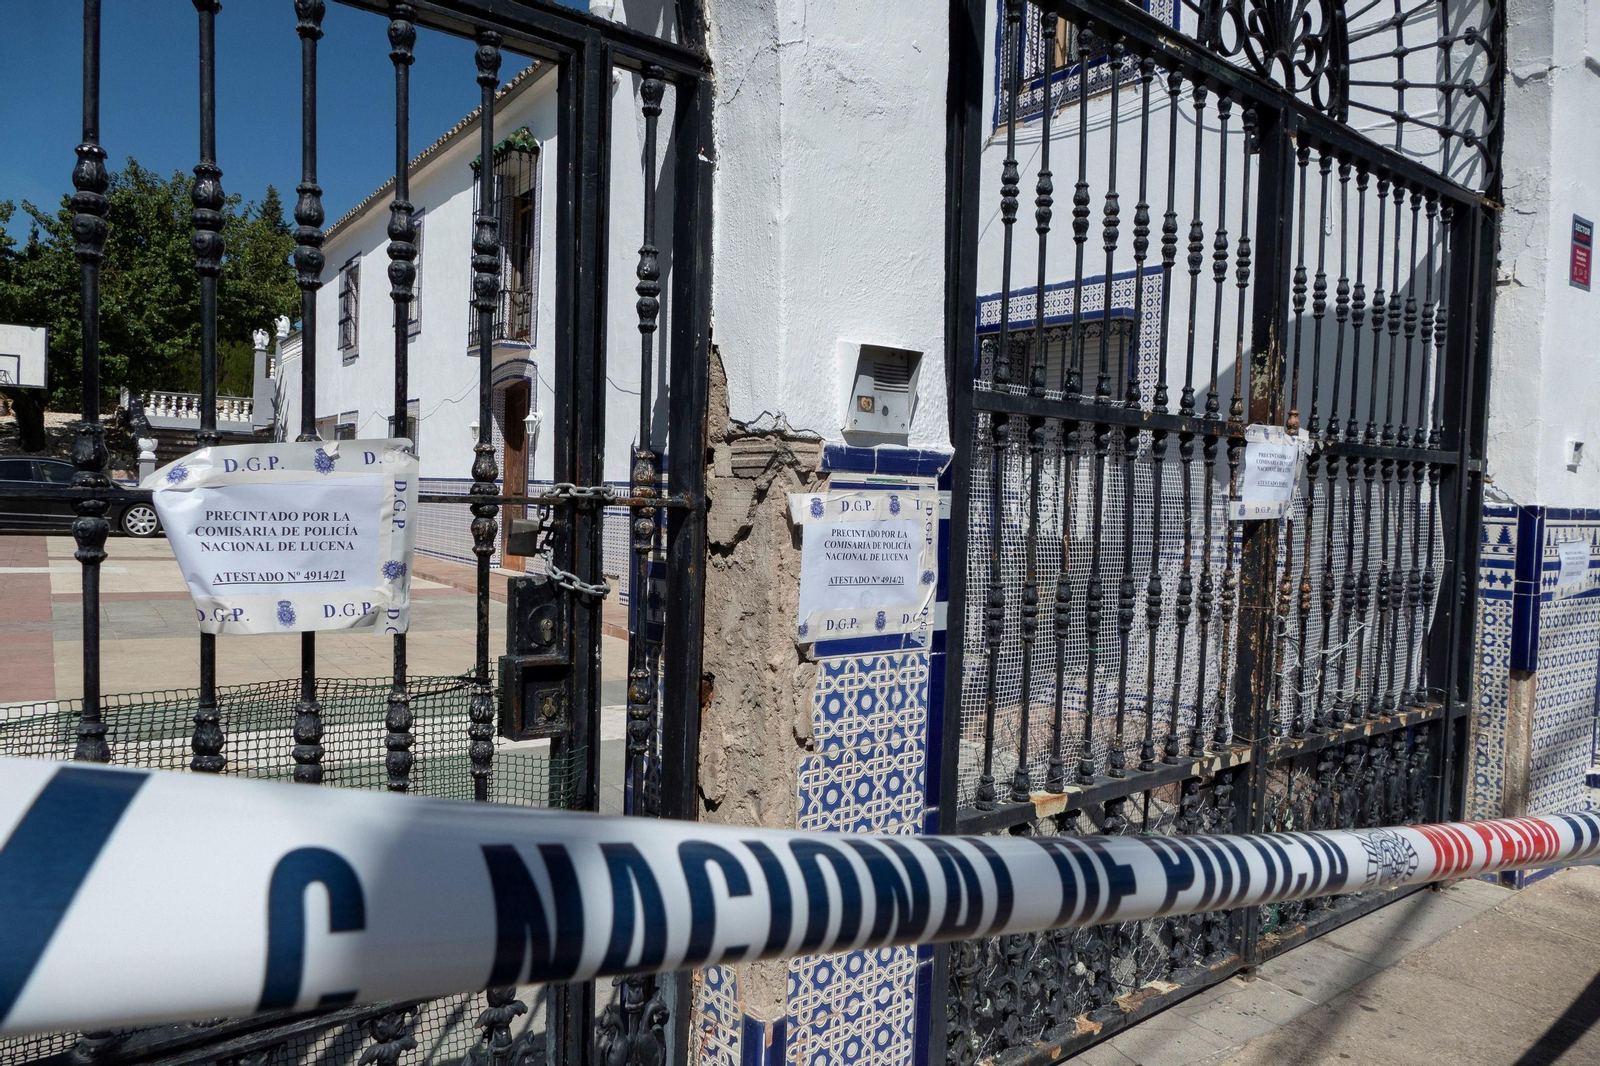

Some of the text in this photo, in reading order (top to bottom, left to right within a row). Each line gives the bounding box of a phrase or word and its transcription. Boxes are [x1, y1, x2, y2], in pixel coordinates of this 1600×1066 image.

[223, 455, 285, 474] D.G.P.
[392, 479, 407, 533] D.G.P.
[841, 500, 875, 512] D.G.P.
[1255, 506, 1272, 514] D.G.P.
[205, 510, 350, 522] PRECINTADO POR LA
[195, 524, 358, 536] COMISARIA DE POLICÍA
[831, 528, 908, 538] PRECINTADO POR LA
[201, 540, 355, 552] NACIONAL DE LUCENA
[824, 539, 912, 549] COMISARIA DE POLICÍA
[825, 552, 909, 561] NACIONAL DE LUCENA
[213, 571, 284, 583] ATESTADO
[303, 570, 346, 581] 4914/21
[828, 576, 870, 584] ATESTADO
[881, 576, 904, 584] 4914/21
[196, 607, 250, 622] D.G.P.
[323, 602, 375, 618] D.G.P.
[826, 618, 859, 631] D.G.P.
